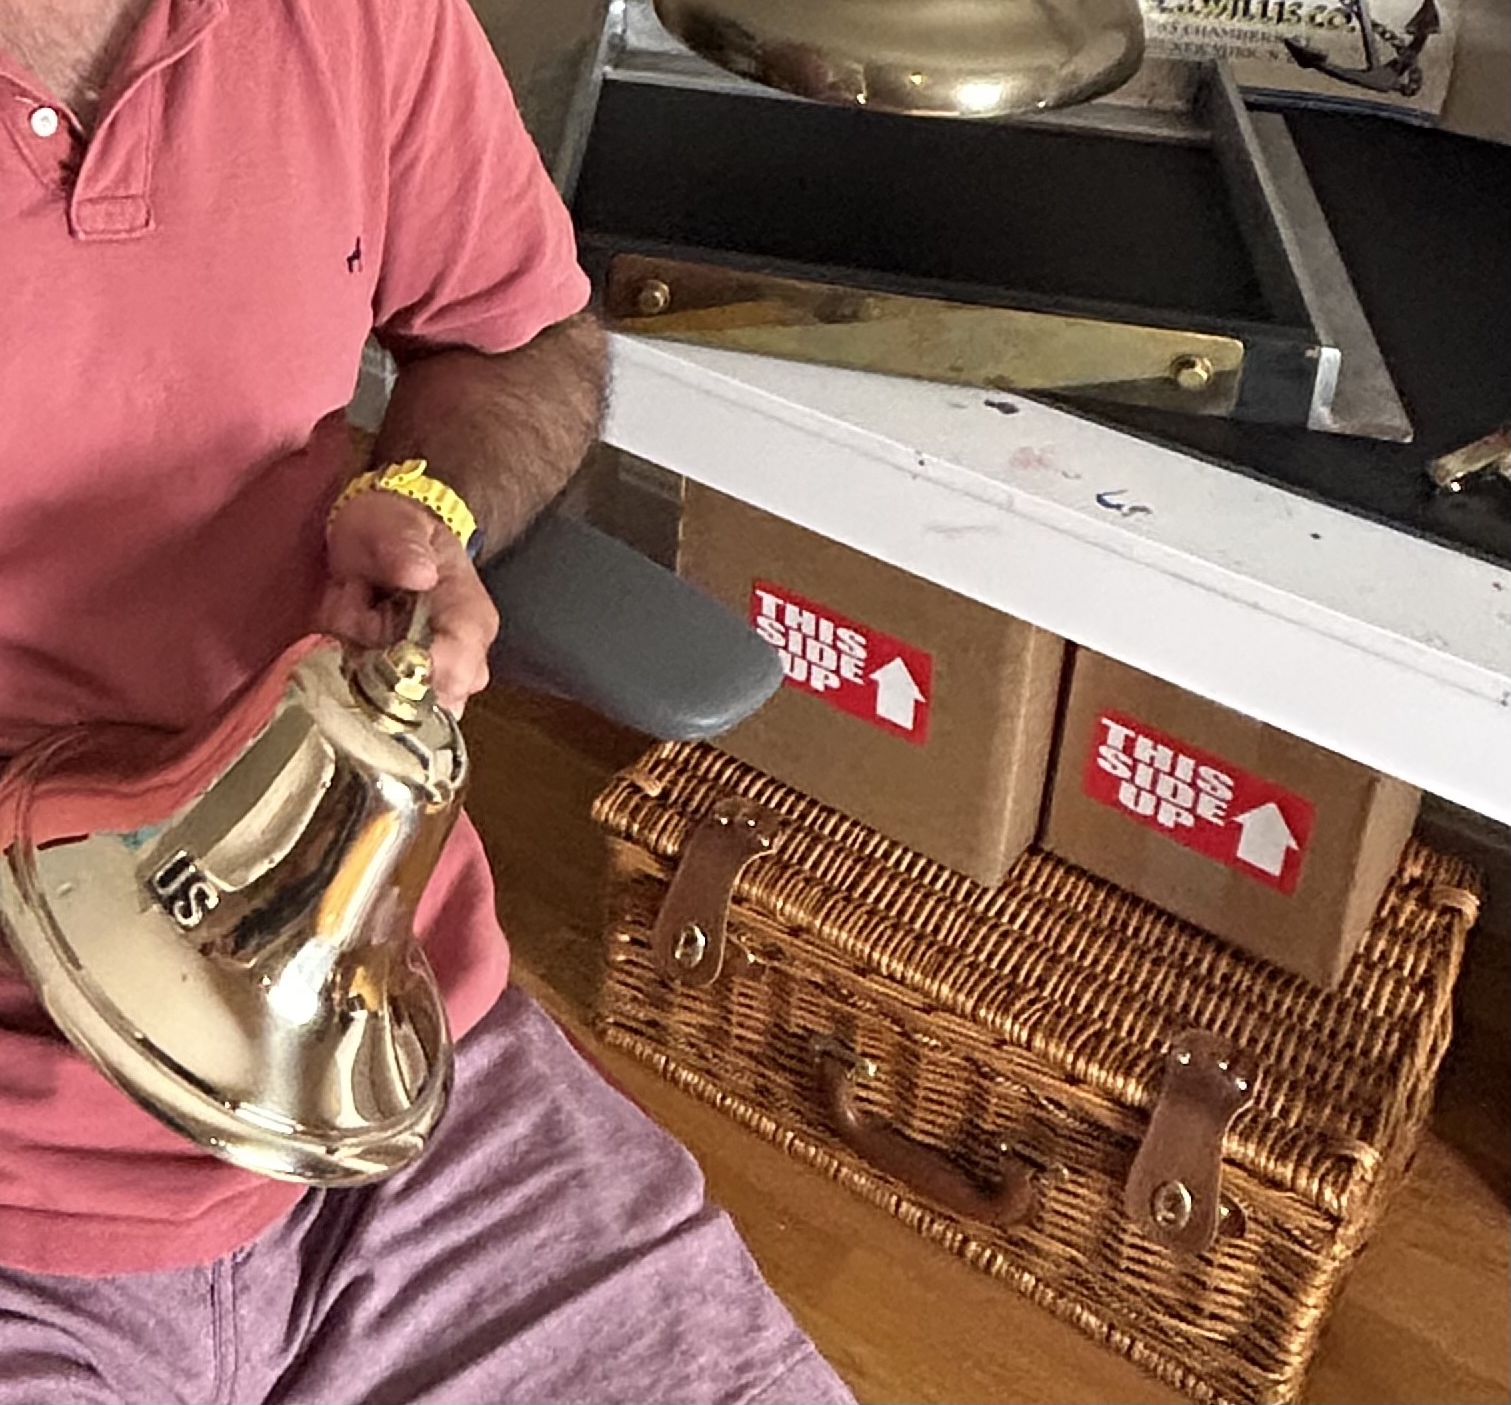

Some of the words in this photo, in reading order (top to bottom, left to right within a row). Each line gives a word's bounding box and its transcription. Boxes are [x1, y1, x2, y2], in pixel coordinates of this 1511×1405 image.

[754, 589, 868, 659] THIS
[756, 615, 866, 685] SIDE
[778, 648, 841, 692] UP
[1096, 745, 1228, 826] SIDE
[1100, 717, 1235, 801] THIS
[1118, 780, 1196, 829] UP
